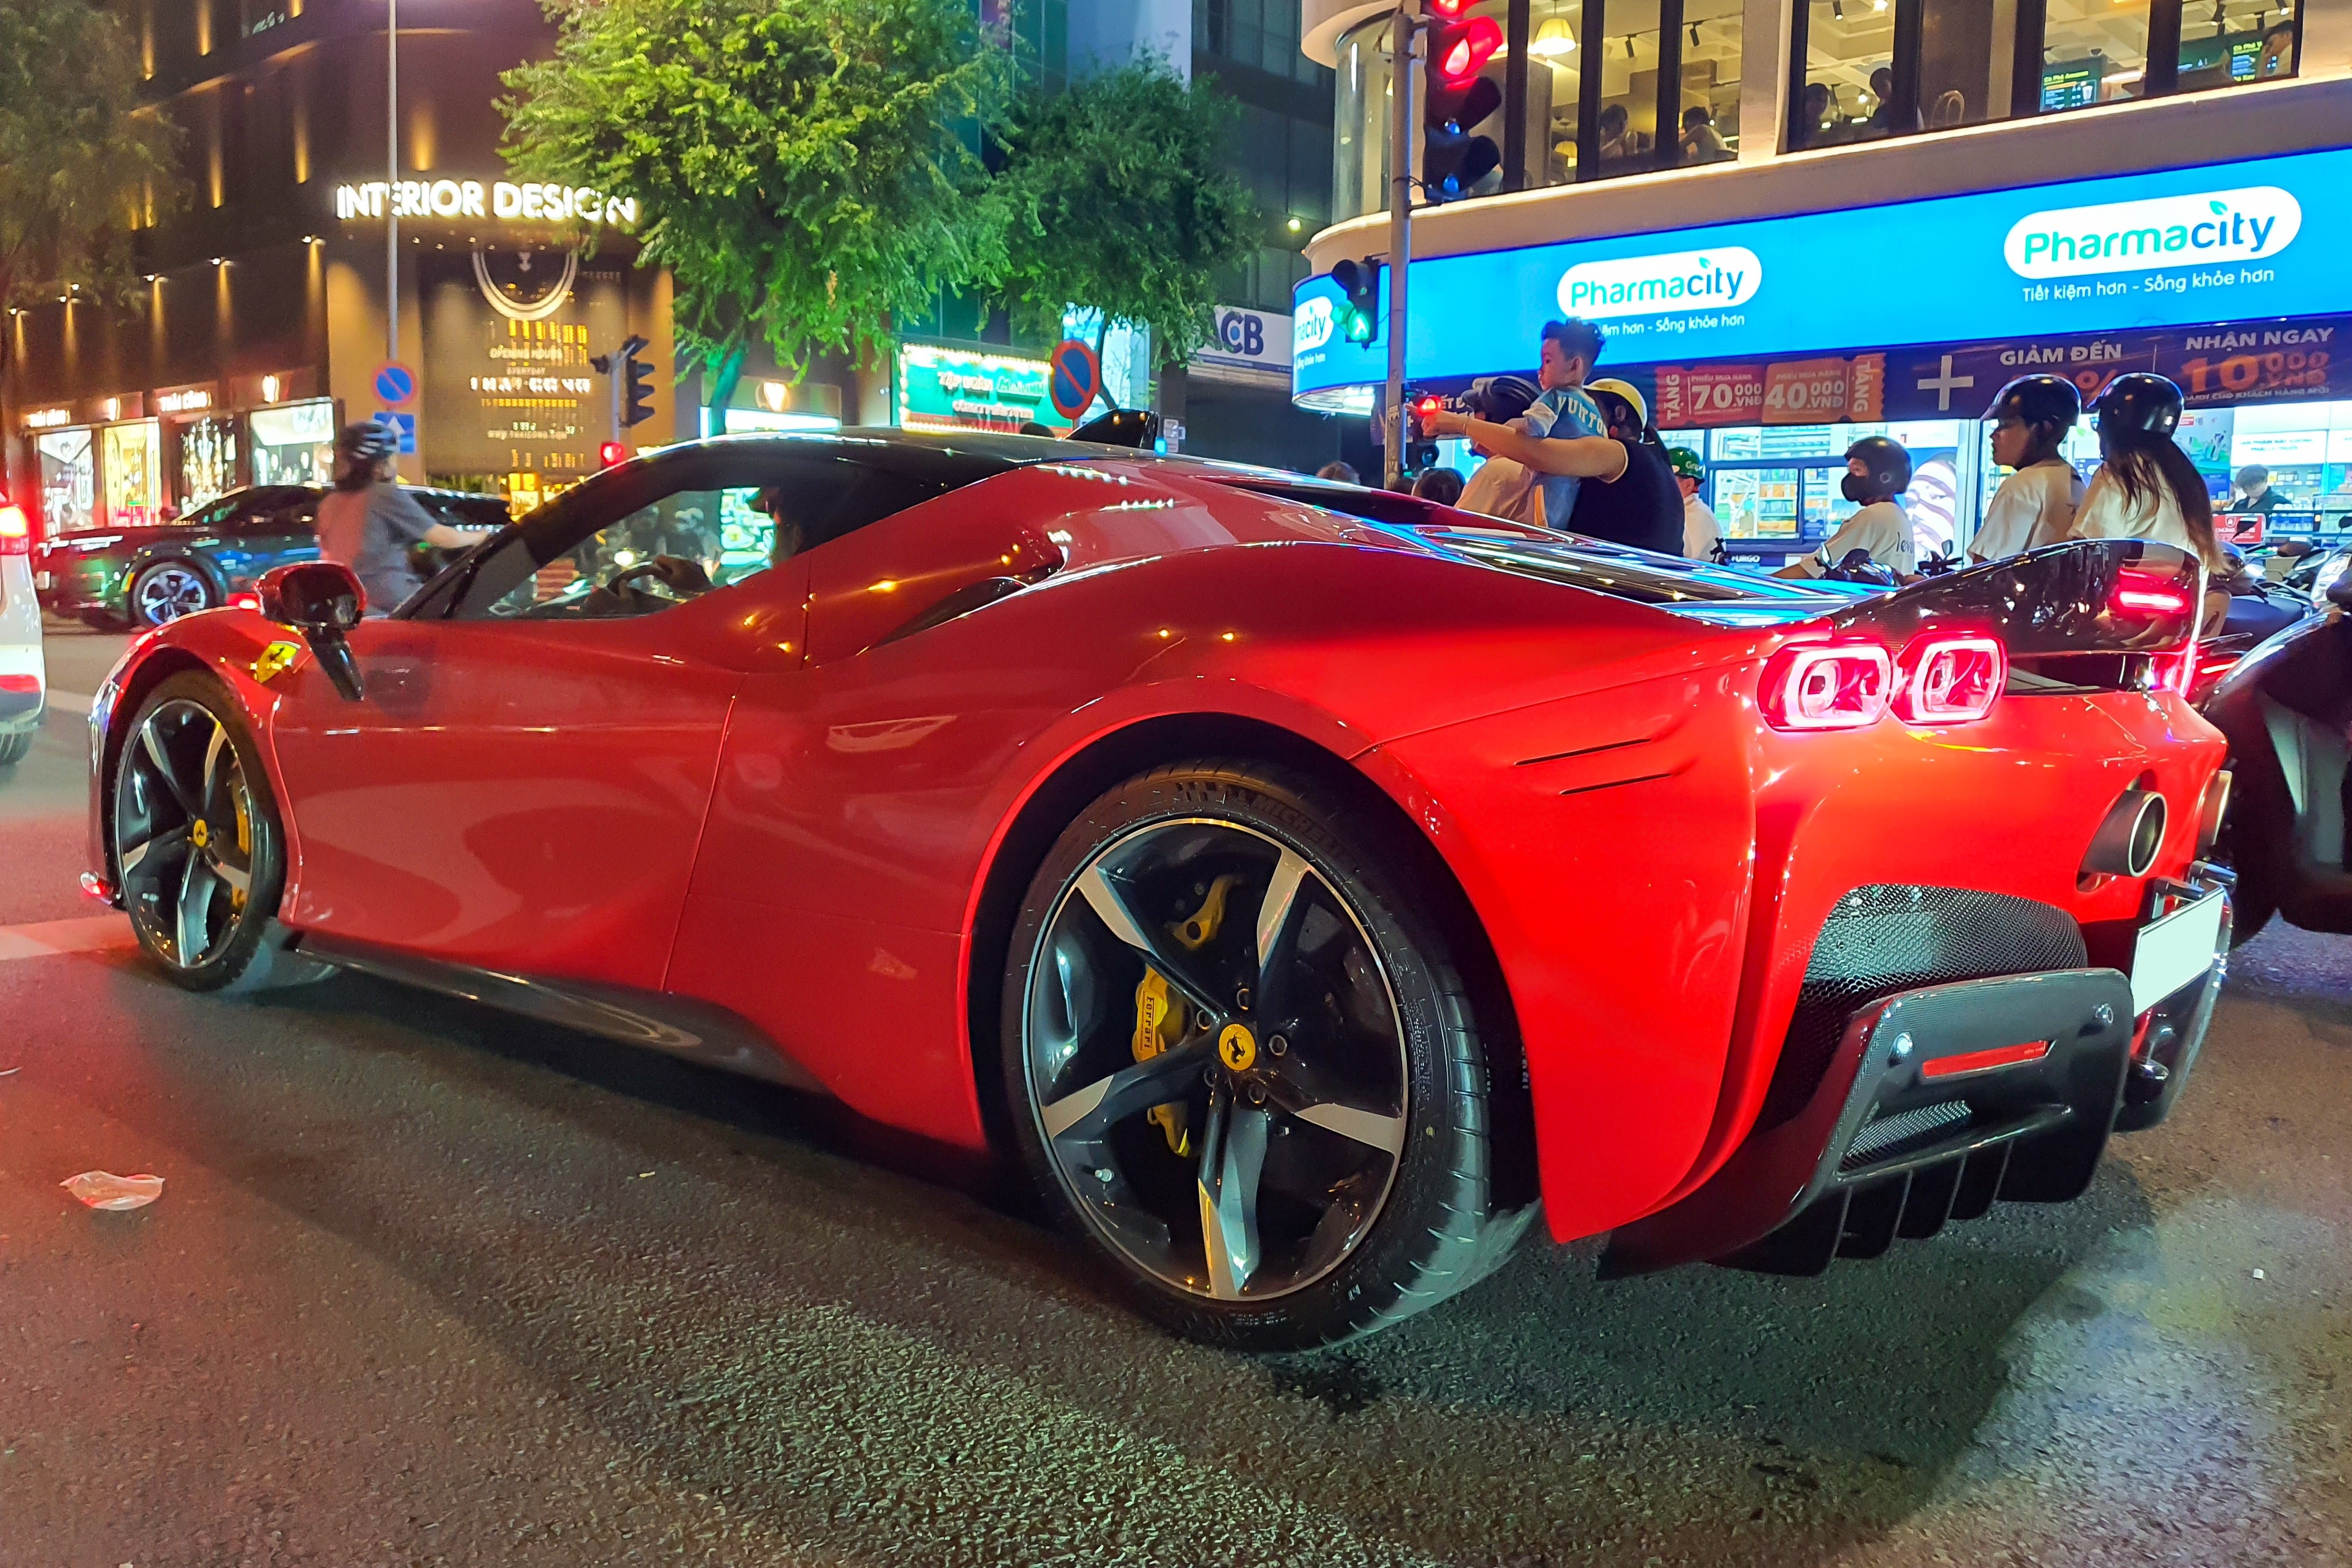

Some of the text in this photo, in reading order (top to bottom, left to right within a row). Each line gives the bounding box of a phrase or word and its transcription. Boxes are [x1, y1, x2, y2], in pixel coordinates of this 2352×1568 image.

[337, 180, 635, 224] INTERIOR DESIGN
[2024, 201, 2276, 264] Pharmacity
[1571, 257, 1744, 308] Pharmacity
[2022, 284, 2049, 302] Tiết
[2054, 284, 2091, 300] kiệm
[2096, 280, 2127, 296] hơn
[2144, 274, 2187, 293] Sống
[2192, 270, 2235, 288] khỏe
[2240, 268, 2274, 284] hơn
[1622, 322, 1644, 335] hơn
[1656, 316, 1685, 333] Sống
[1689, 314, 1718, 330] khỏe
[1721, 313, 1745, 327] hơn
[2185, 327, 2334, 351] NHẬN NGAY
[2000, 339, 2122, 366] GIẢM ĐẾN
[1853, 360, 1874, 412] TẶNG
[2181, 354, 2259, 393] 10
[1664, 374, 1684, 421] TẶNG
[1692, 383, 1762, 410] 70 000
[1766, 380, 1845, 410] 40 000
[1144, 995, 1154, 1048] Ferrari
